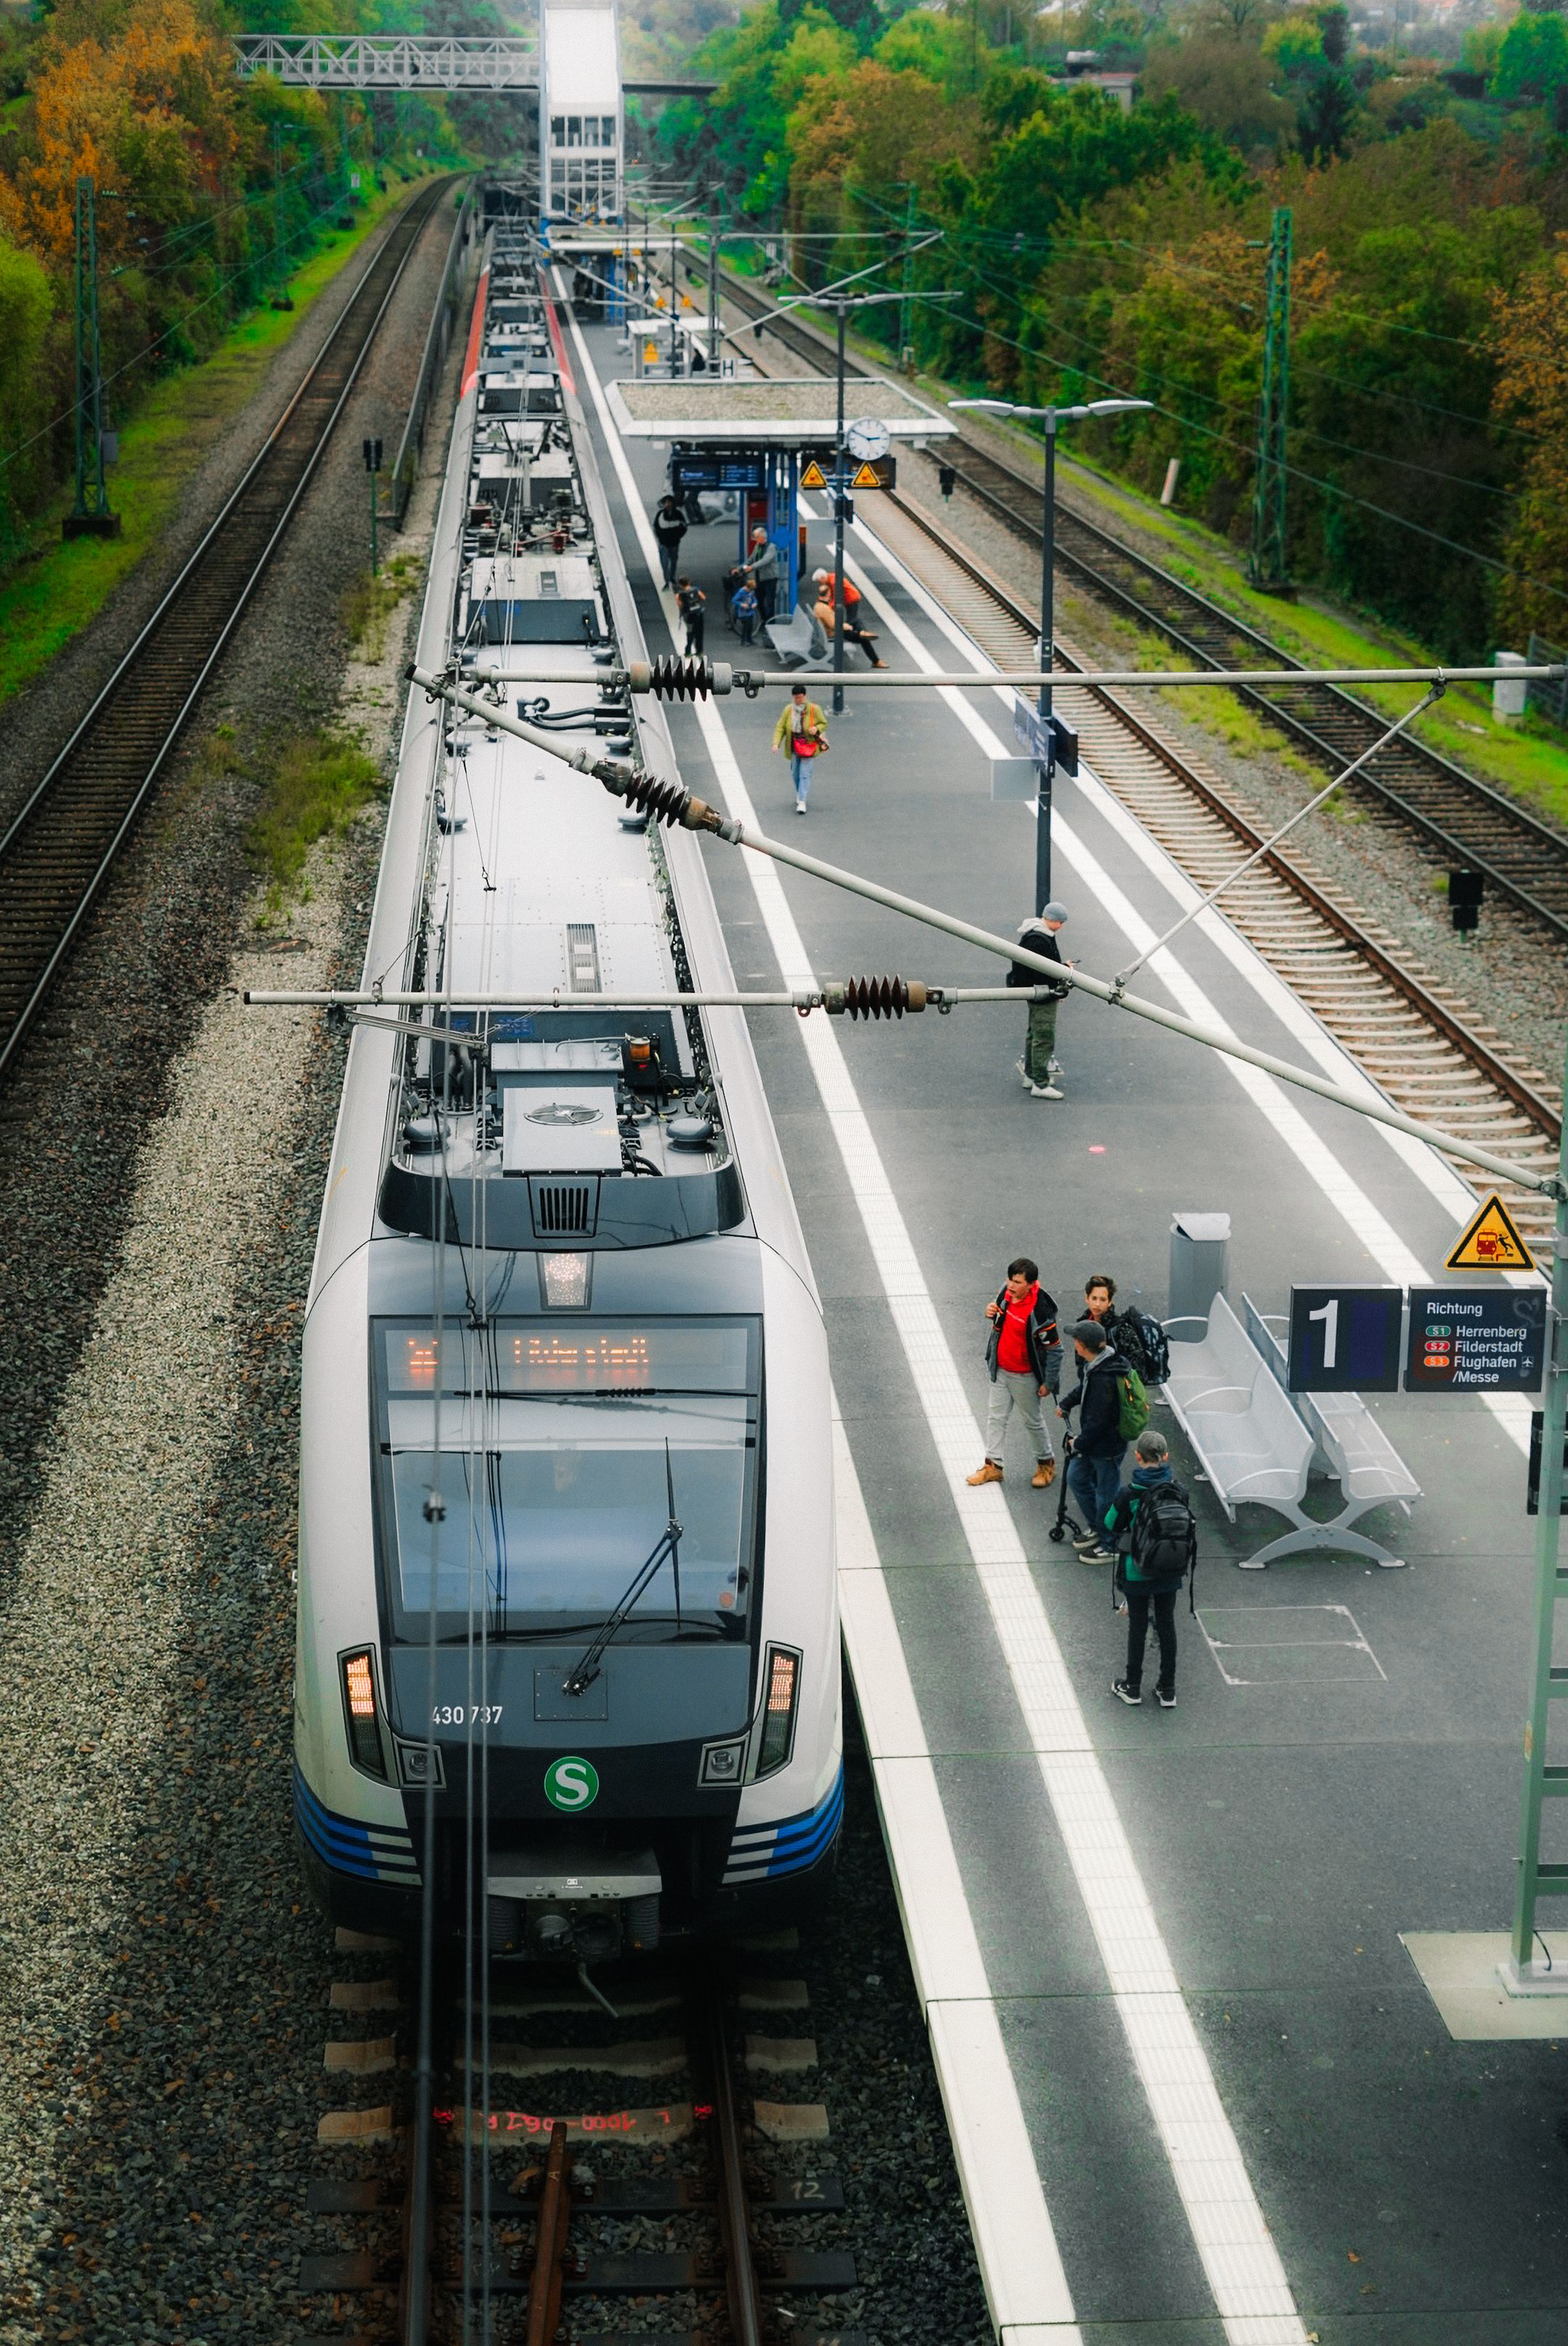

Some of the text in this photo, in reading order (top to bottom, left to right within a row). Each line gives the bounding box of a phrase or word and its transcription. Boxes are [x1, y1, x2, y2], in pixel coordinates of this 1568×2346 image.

[722, 359, 734, 377] H
[1426, 1301, 1483, 1317] Richtung
[1309, 1299, 1339, 1368] 1
[1455, 1325, 1527, 1340] Herrenberg
[1455, 1341, 1524, 1353] Filderstadt
[1453, 1355, 1517, 1370] Flughafen
[1452, 1370, 1500, 1384] /Messe
[432, 1706, 503, 1725] 430 737
[555, 1762, 589, 1806] S
[791, 2181, 825, 2200] 12
